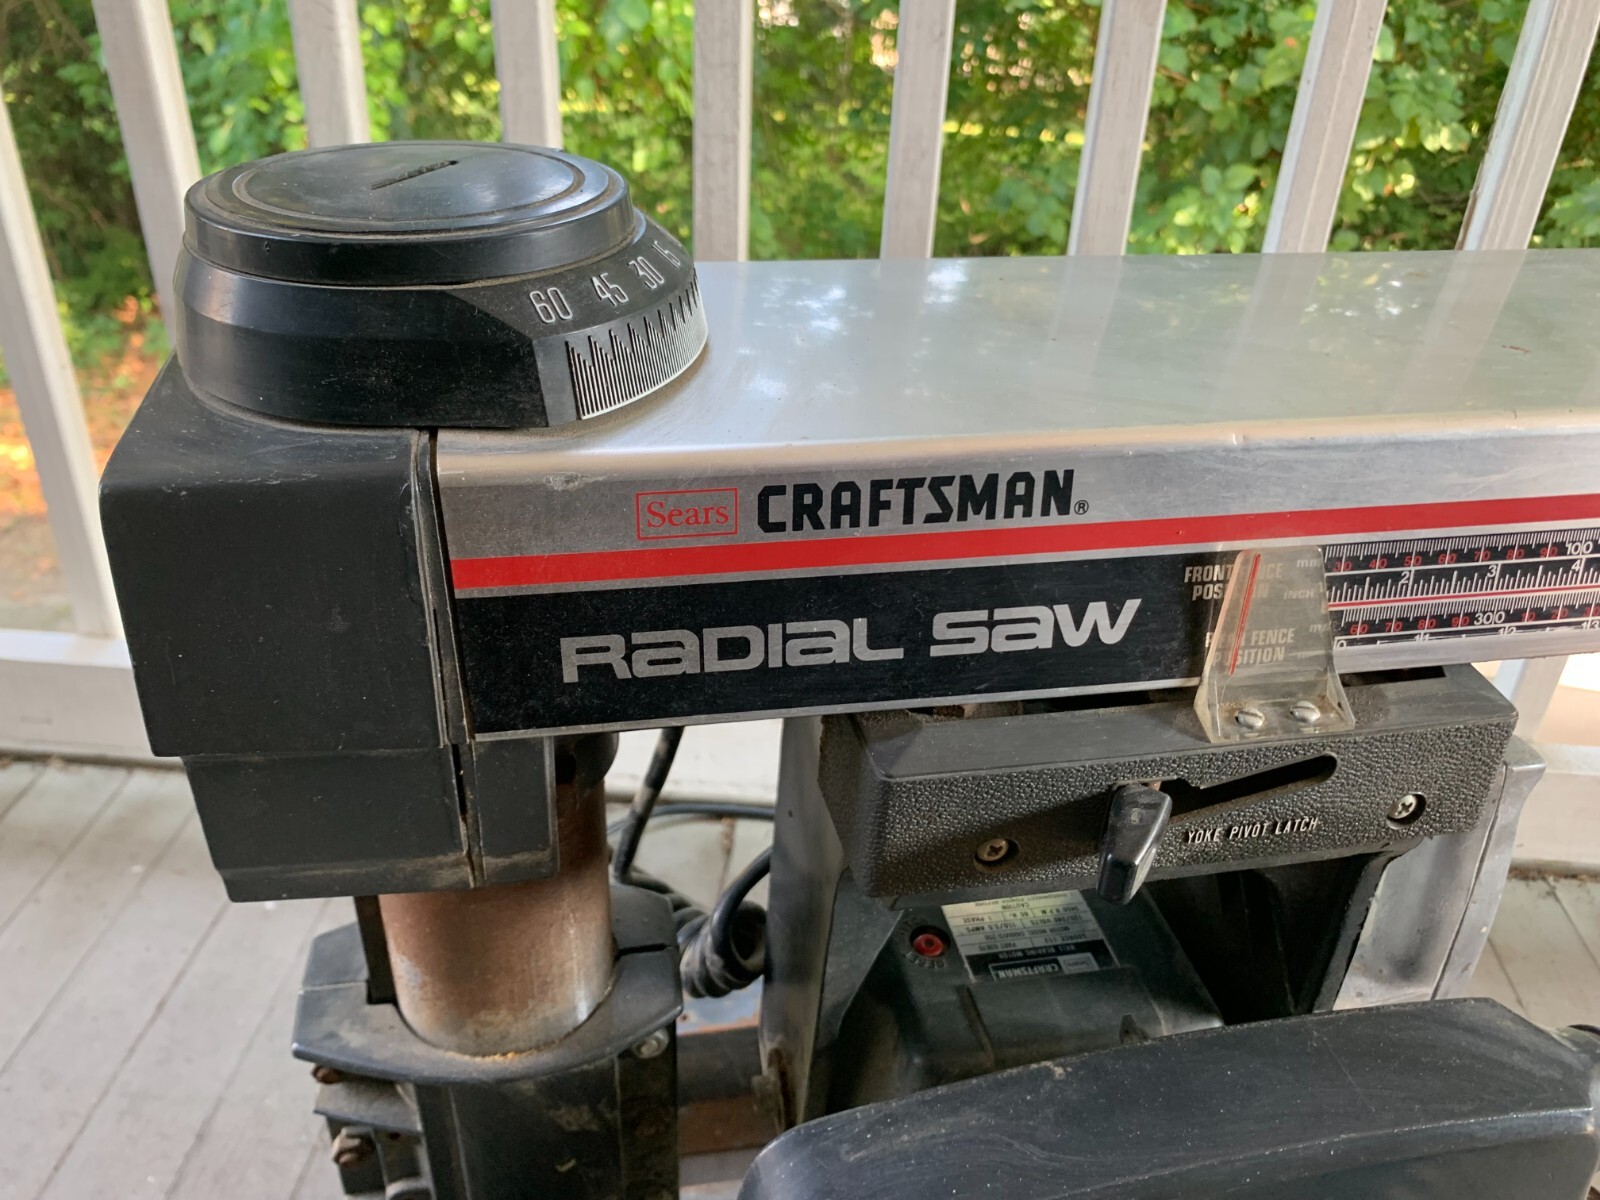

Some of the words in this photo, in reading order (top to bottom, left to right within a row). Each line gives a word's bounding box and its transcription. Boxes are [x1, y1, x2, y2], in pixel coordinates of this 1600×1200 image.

[530, 287, 573, 324] 60
[591, 272, 629, 308] 45
[628, 256, 665, 290] 30
[645, 501, 730, 528] Sears
[1333, 561, 1352, 572] 30
[1369, 558, 1387, 569] 40
[1404, 555, 1422, 567] 50
[1438, 553, 1457, 564] 60
[1474, 550, 1491, 561] 70
[1506, 548, 1524, 560] 80
[1541, 546, 1558, 557] 90
[1566, 541, 1593, 555] 100
[1399, 571, 1410, 584] 2
[1487, 564, 1497, 578] 3
[1571, 559, 1581, 572] 4
[1350, 623, 1368, 635] 60
[1385, 621, 1403, 632] 70
[1418, 618, 1436, 630] 80
[1451, 616, 1469, 627] 90
[1474, 611, 1505, 625] 300
[1521, 611, 1536, 622] 10
[1551, 608, 1568, 619] 20
[1250, 628, 1295, 646] FENCE
[1187, 827, 1223, 845] YOKE
[1229, 822, 1271, 840] PIVOT
[1274, 816, 1319, 835] LATCH
